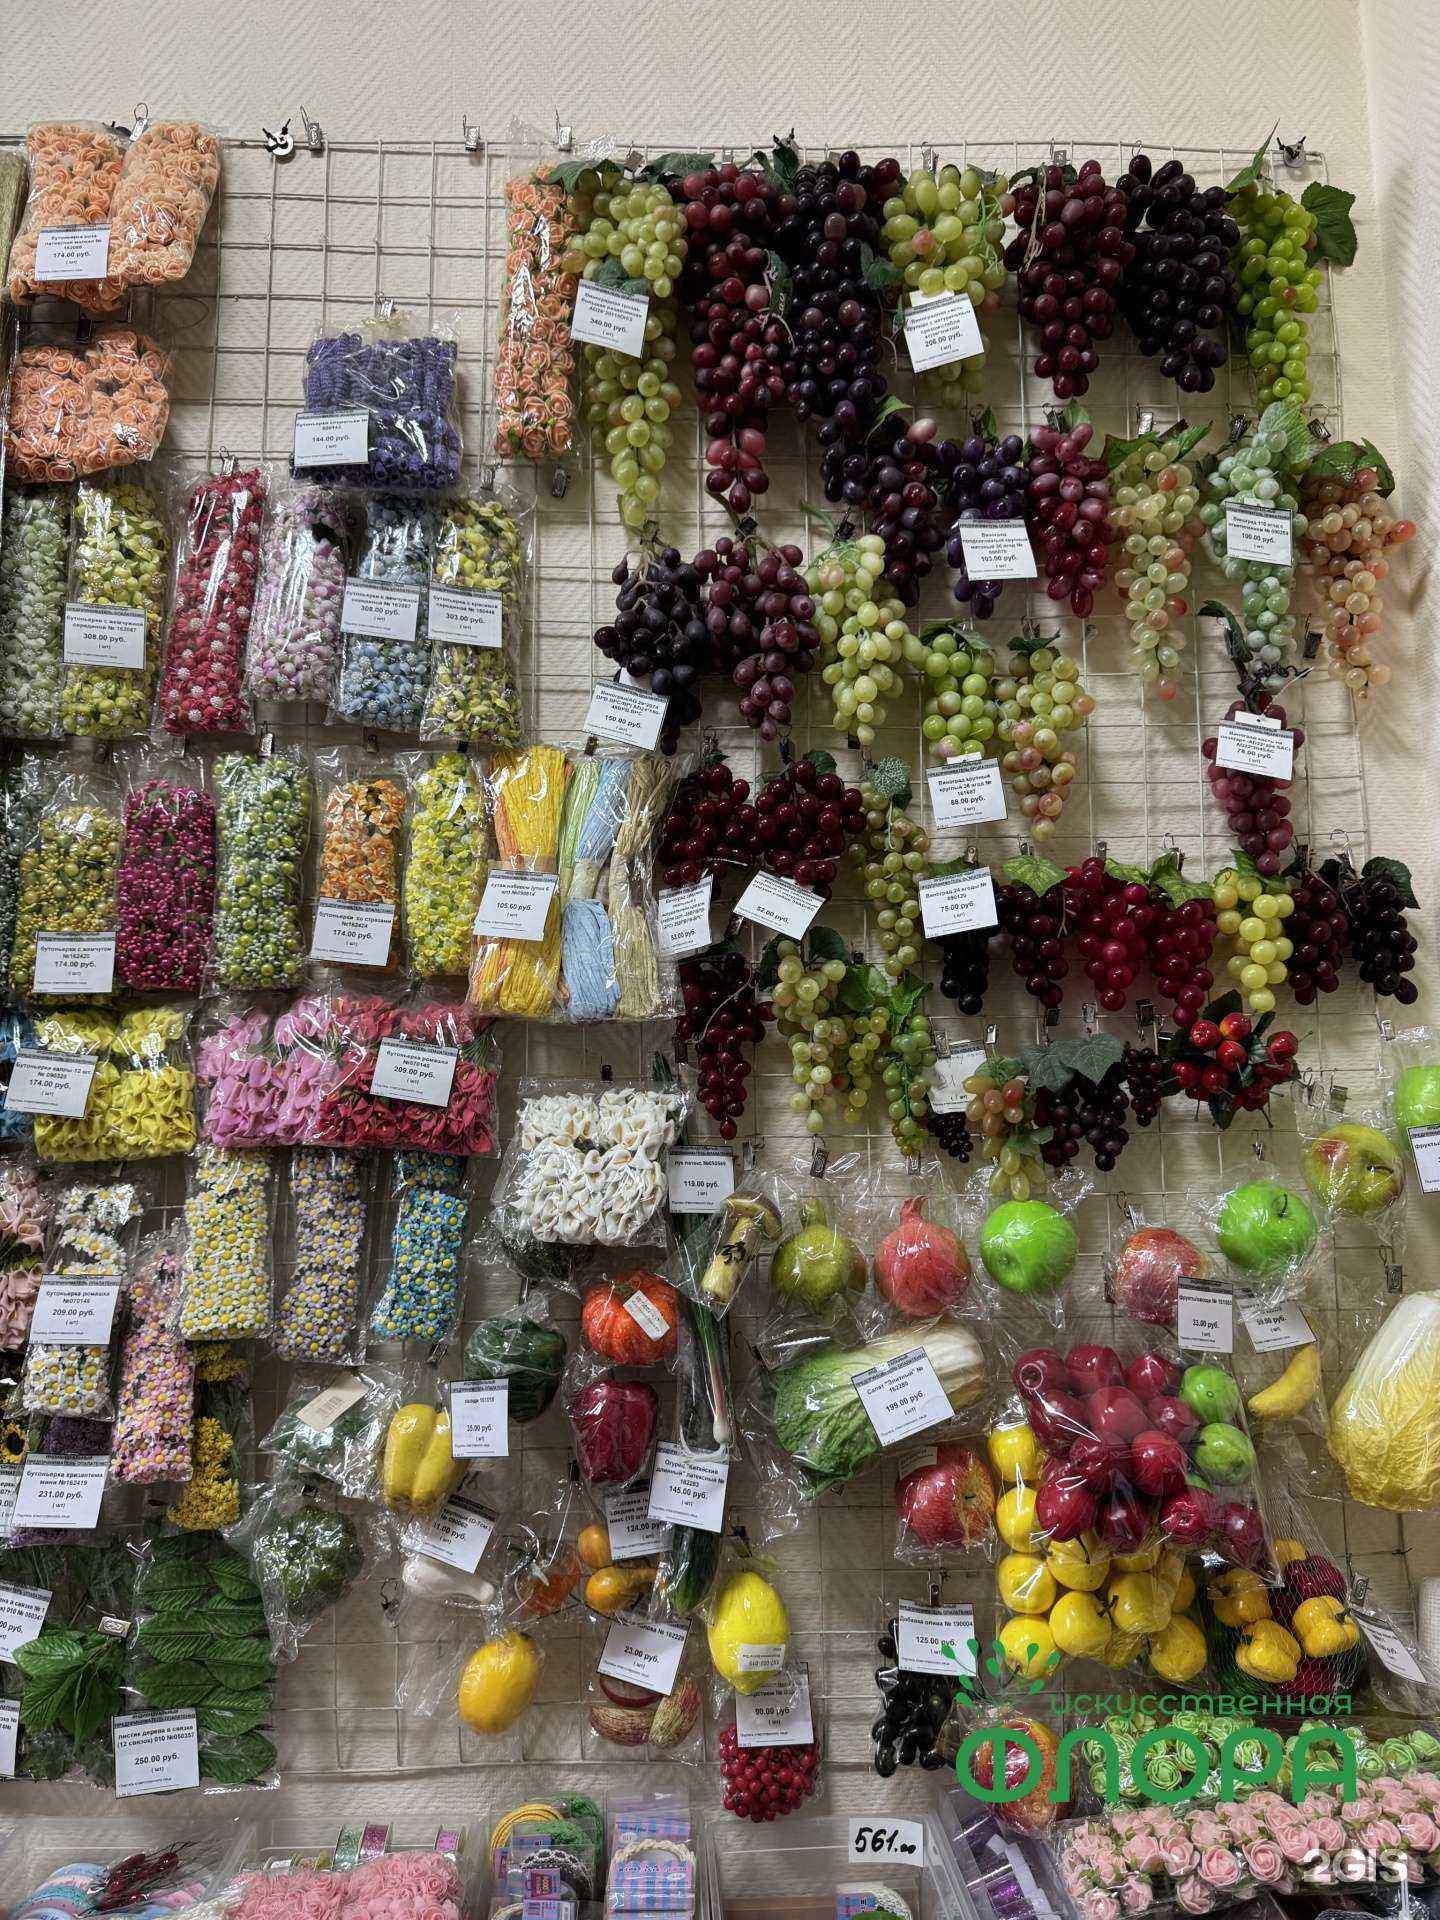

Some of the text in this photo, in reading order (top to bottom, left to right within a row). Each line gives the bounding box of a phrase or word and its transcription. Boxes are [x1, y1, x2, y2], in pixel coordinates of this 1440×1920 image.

[76, 251, 91, 259] руб.
[335, 434, 351, 443] руб.
[970, 796, 986, 806] руб.
[357, 933, 374, 941] руб.
[80, 961, 97, 969] руб.
[393, 1065, 436, 1080] 209.00 руб.
[29, 1078, 72, 1090] 174.00 руб.
[706, 1181, 720, 1189] руб.
[52, 1308, 95, 1317] 209.00 руб.
[1207, 1320, 1220, 1330] руб.
[885, 1390, 927, 1413] 199.00 руб.
[481, 1424, 495, 1433] руб.
[38, 1490, 83, 1500] 231.00 руб.
[669, 1485, 709, 1500] 145.00 руб.
[625, 1521, 650, 1533] 124.00
[451, 1528, 467, 1541] руб.
[7, 1623, 23, 1633] руб.
[916, 1636, 939, 1646] 125.00
[643, 1652, 660, 1664] руб.
[134, 1751, 180, 1766] 250.00 руб.
